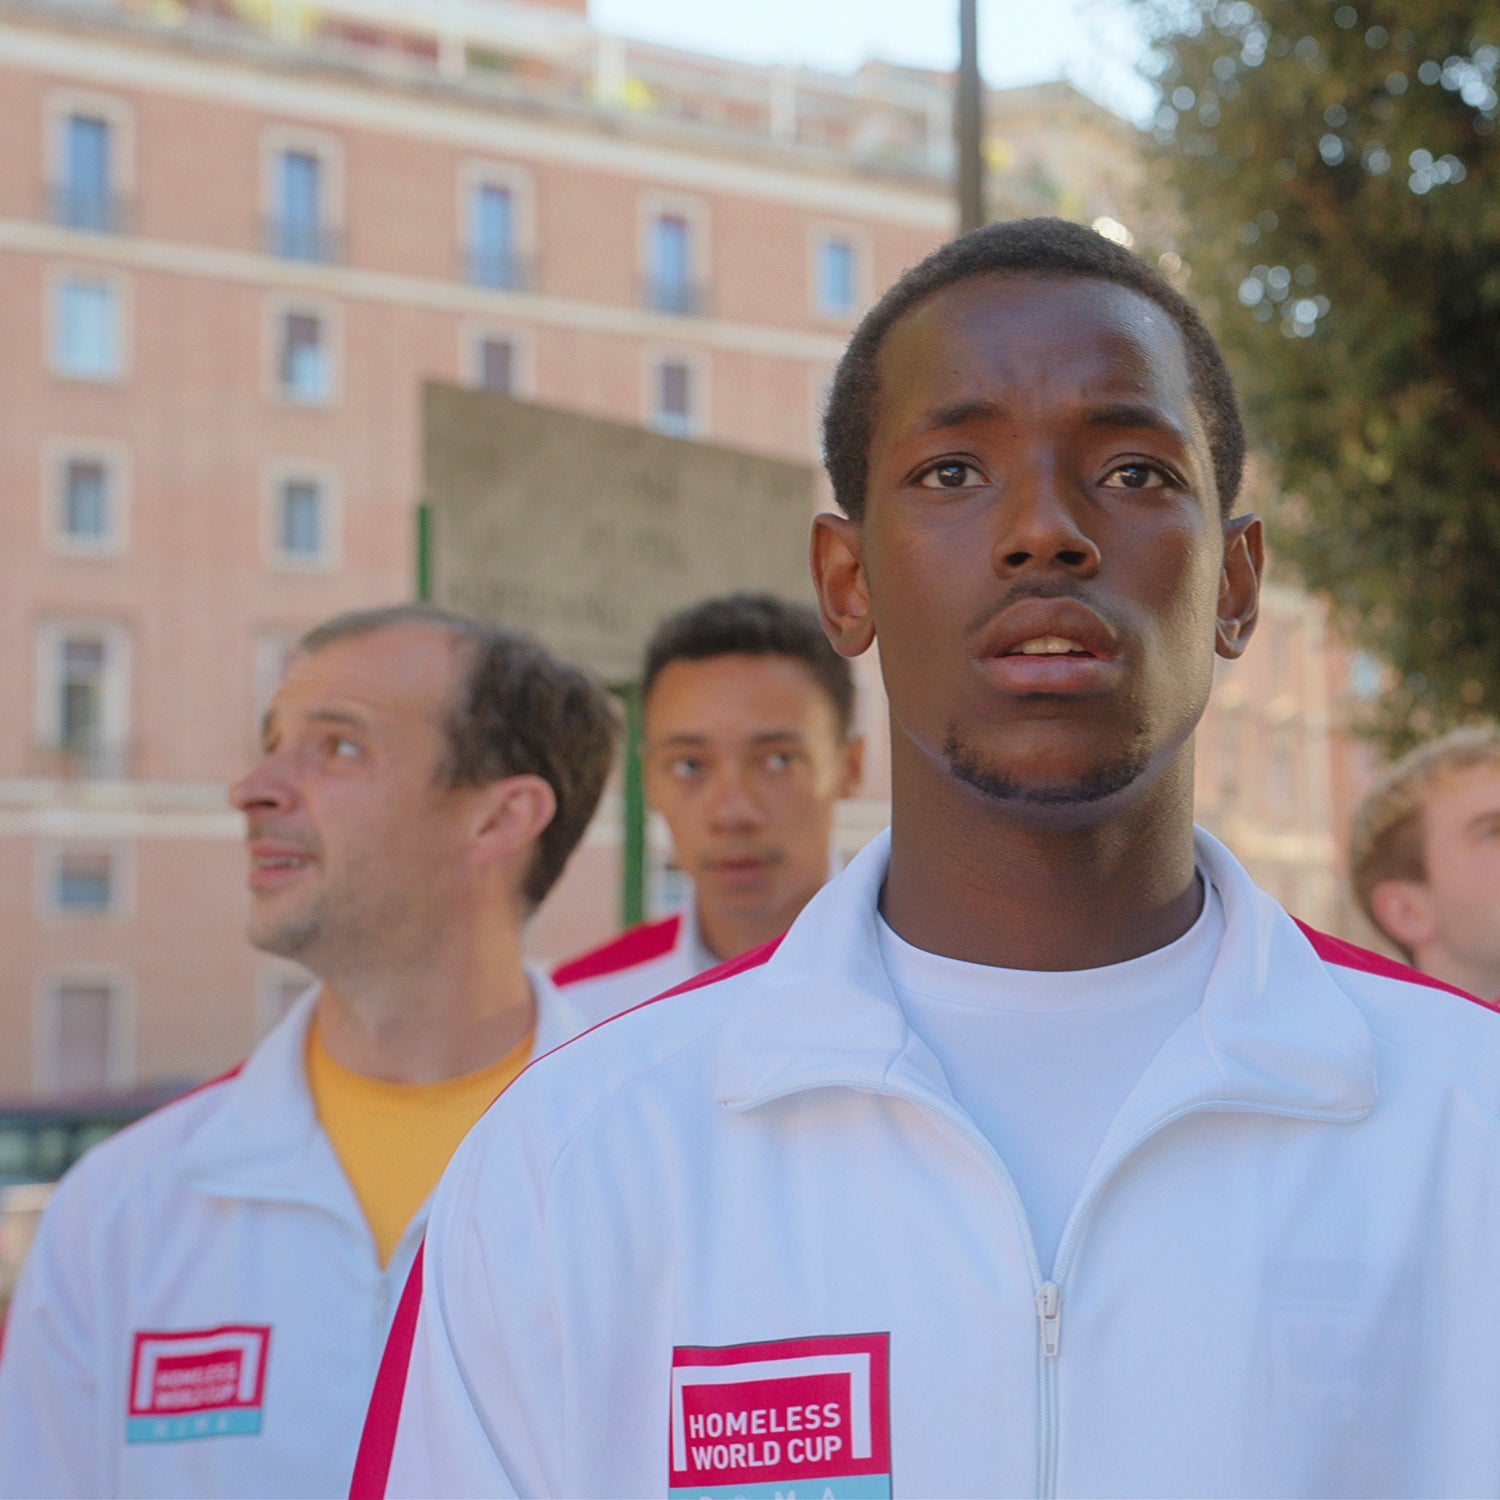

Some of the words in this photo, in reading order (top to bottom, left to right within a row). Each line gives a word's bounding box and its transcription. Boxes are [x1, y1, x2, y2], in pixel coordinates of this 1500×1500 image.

[688, 1403, 841, 1439] HOMELESS
[691, 1441, 781, 1471] WORLD
[787, 1435, 842, 1463] CUP
